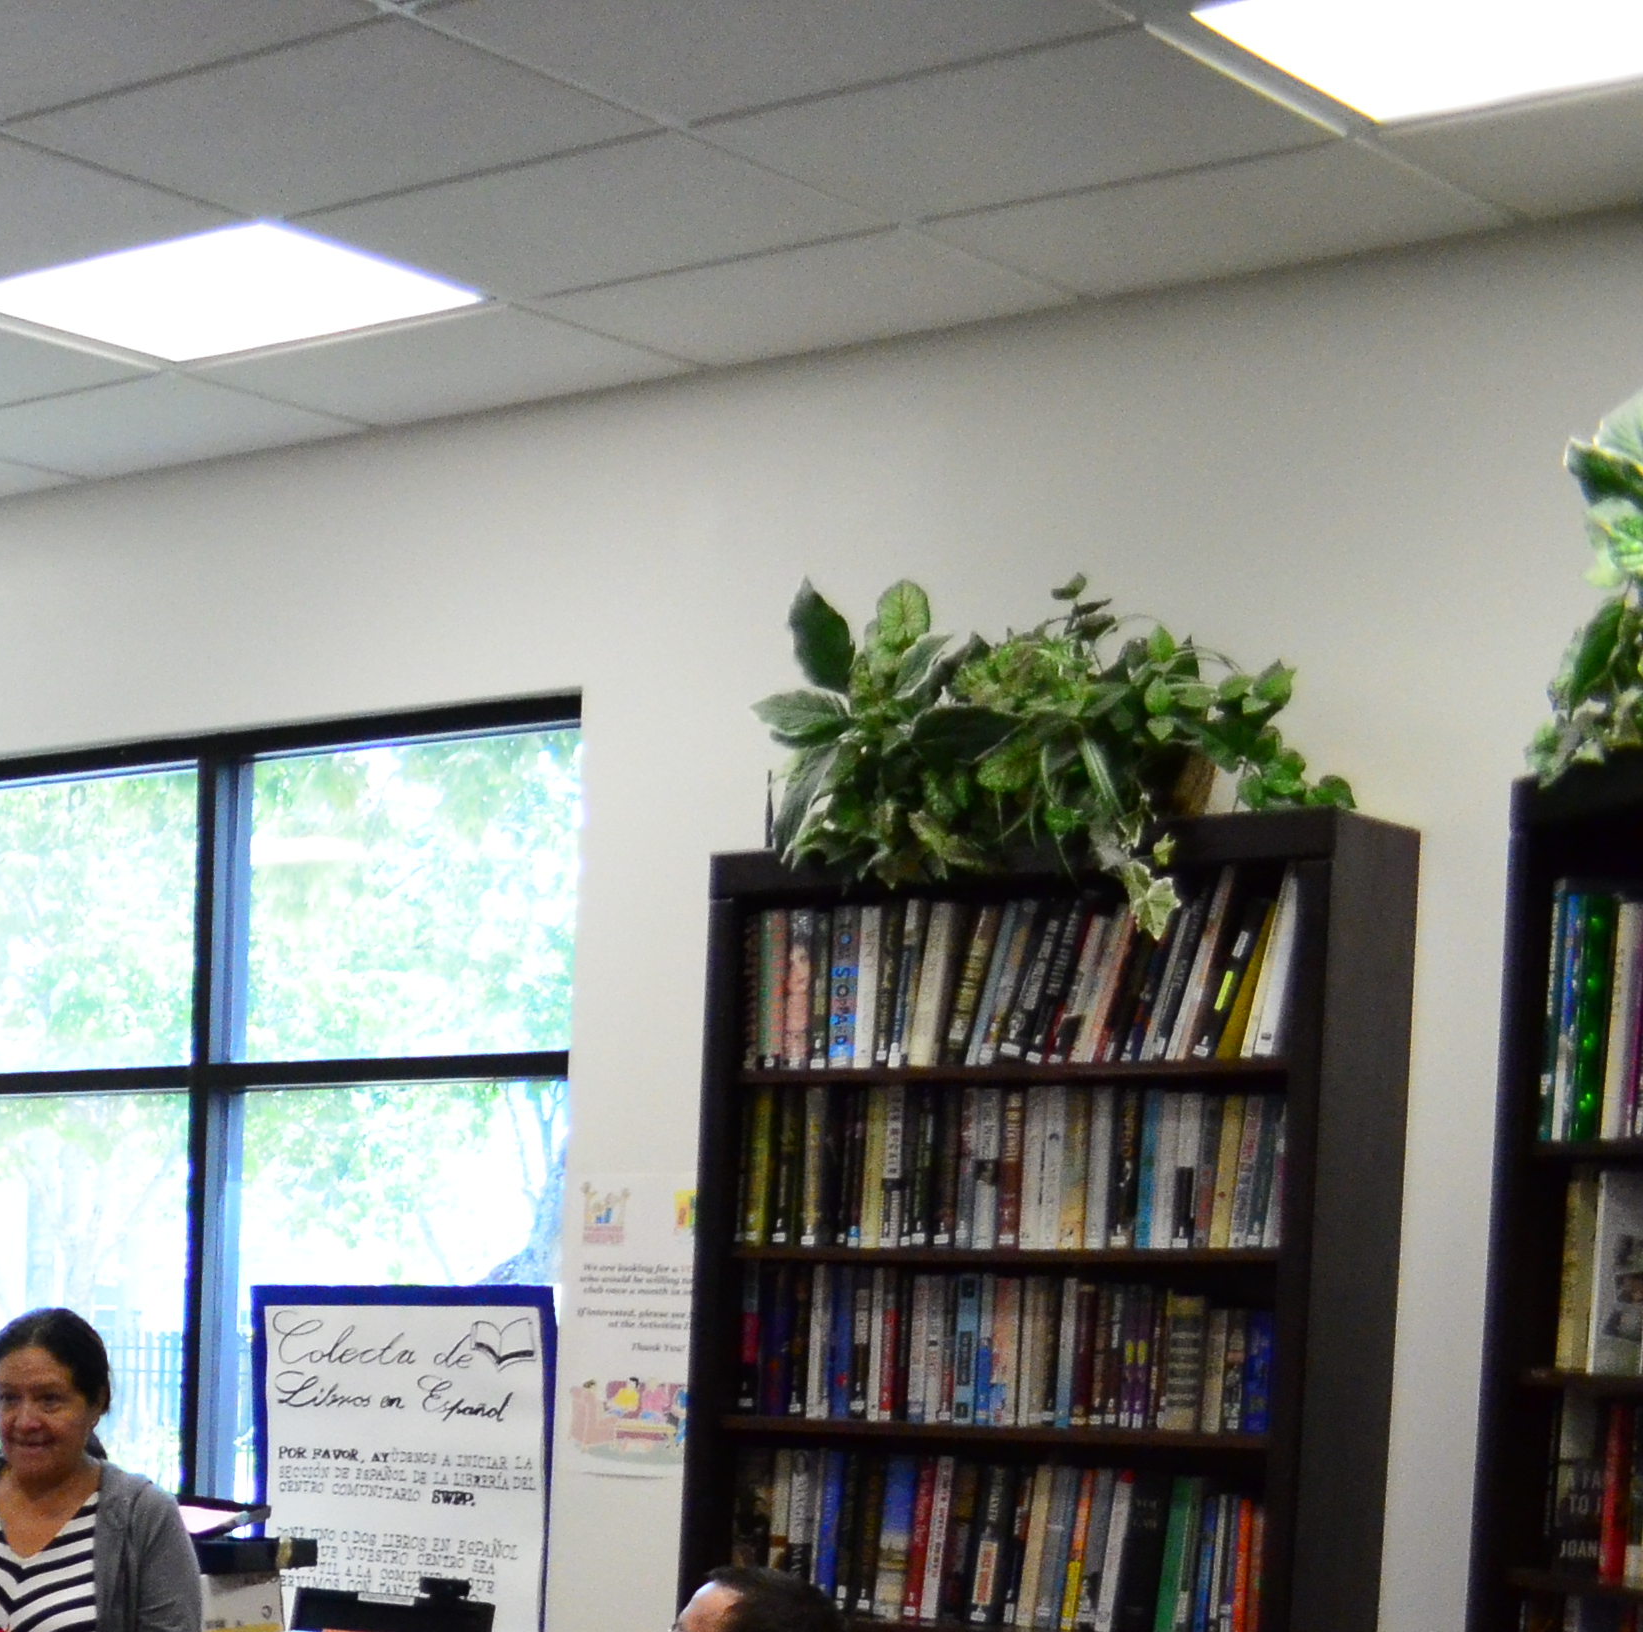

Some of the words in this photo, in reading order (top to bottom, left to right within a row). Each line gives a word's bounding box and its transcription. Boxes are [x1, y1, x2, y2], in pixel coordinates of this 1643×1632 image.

[272, 1310, 416, 1366] Colecta
[434, 1334, 474, 1369] de
[275, 1371, 372, 1408] Libros
[380, 1397, 406, 1410] en
[417, 1375, 514, 1423] Español
[278, 1445, 307, 1459] POR
[312, 1448, 365, 1464] FAVOR,
[441, 1455, 451, 1466] A
[456, 1454, 508, 1470] INICIAR
[515, 1455, 533, 1470] LA
[279, 1462, 330, 1479] SECCIÓN
[334, 1466, 350, 1479] DE
[355, 1465, 407, 1482] ESPAÑOL
[413, 1470, 427, 1485] DE
[433, 1471, 449, 1485] LA
[513, 1476, 537, 1491] DEL
[279, 1480, 324, 1494] CENTRO
[331, 1483, 420, 1502] COMUNITARIO
[321, 1545, 338, 1558] UE
[346, 1545, 408, 1566] NUESTRO
[417, 1552, 465, 1569] CENTRO
[472, 1559, 495, 1575] SEA
[340, 1530, 349, 1543] O
[352, 1530, 377, 1546] DOS
[382, 1532, 426, 1552] LIBROS
[432, 1537, 451, 1552] EN
[457, 1538, 518, 1560] ESPAÑOL
